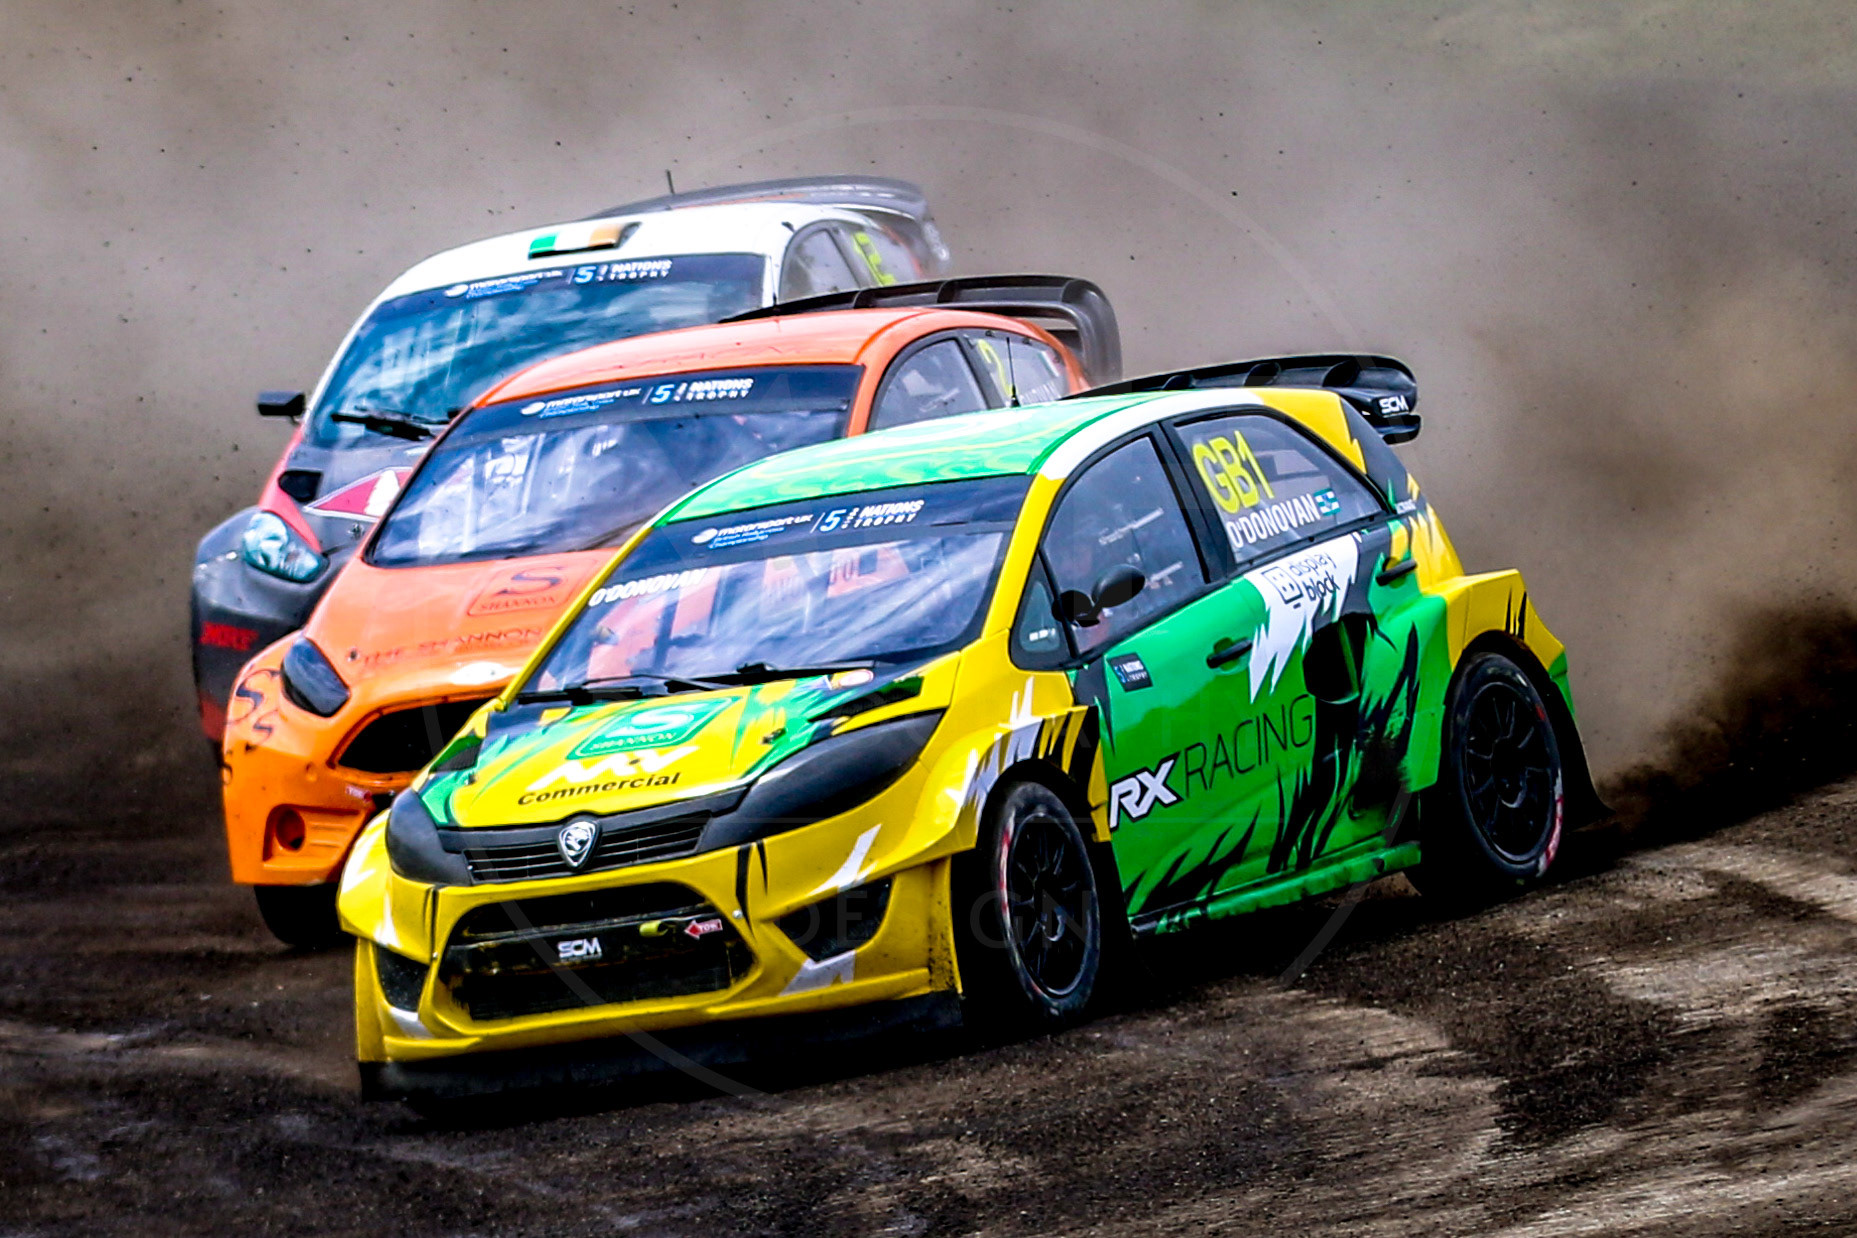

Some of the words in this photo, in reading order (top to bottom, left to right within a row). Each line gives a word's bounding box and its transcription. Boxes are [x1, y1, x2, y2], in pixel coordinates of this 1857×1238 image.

[574, 265, 597, 284] 5
[611, 260, 673, 274] NATIONS
[609, 270, 670, 281] TROPHY
[650, 383, 675, 403] 5
[690, 378, 755, 392] NATIONS
[686, 389, 750, 401] TROPHY
[1379, 394, 1410, 415] SCM
[1192, 430, 1275, 515] GB1
[717, 516, 793, 538] motorsport
[819, 508, 847, 533] 5
[859, 498, 925, 519] NATIONS
[854, 512, 917, 529] TROPHY
[1226, 492, 1322, 549] O'DONOVAN
[1288, 549, 1338, 588] display
[588, 567, 708, 608] O'DONOVAN
[1302, 570, 1341, 603] block
[1109, 757, 1180, 831] RX
[1184, 694, 1314, 799] RACING
[517, 771, 682, 806] Commercial
[557, 936, 603, 960] SCM
